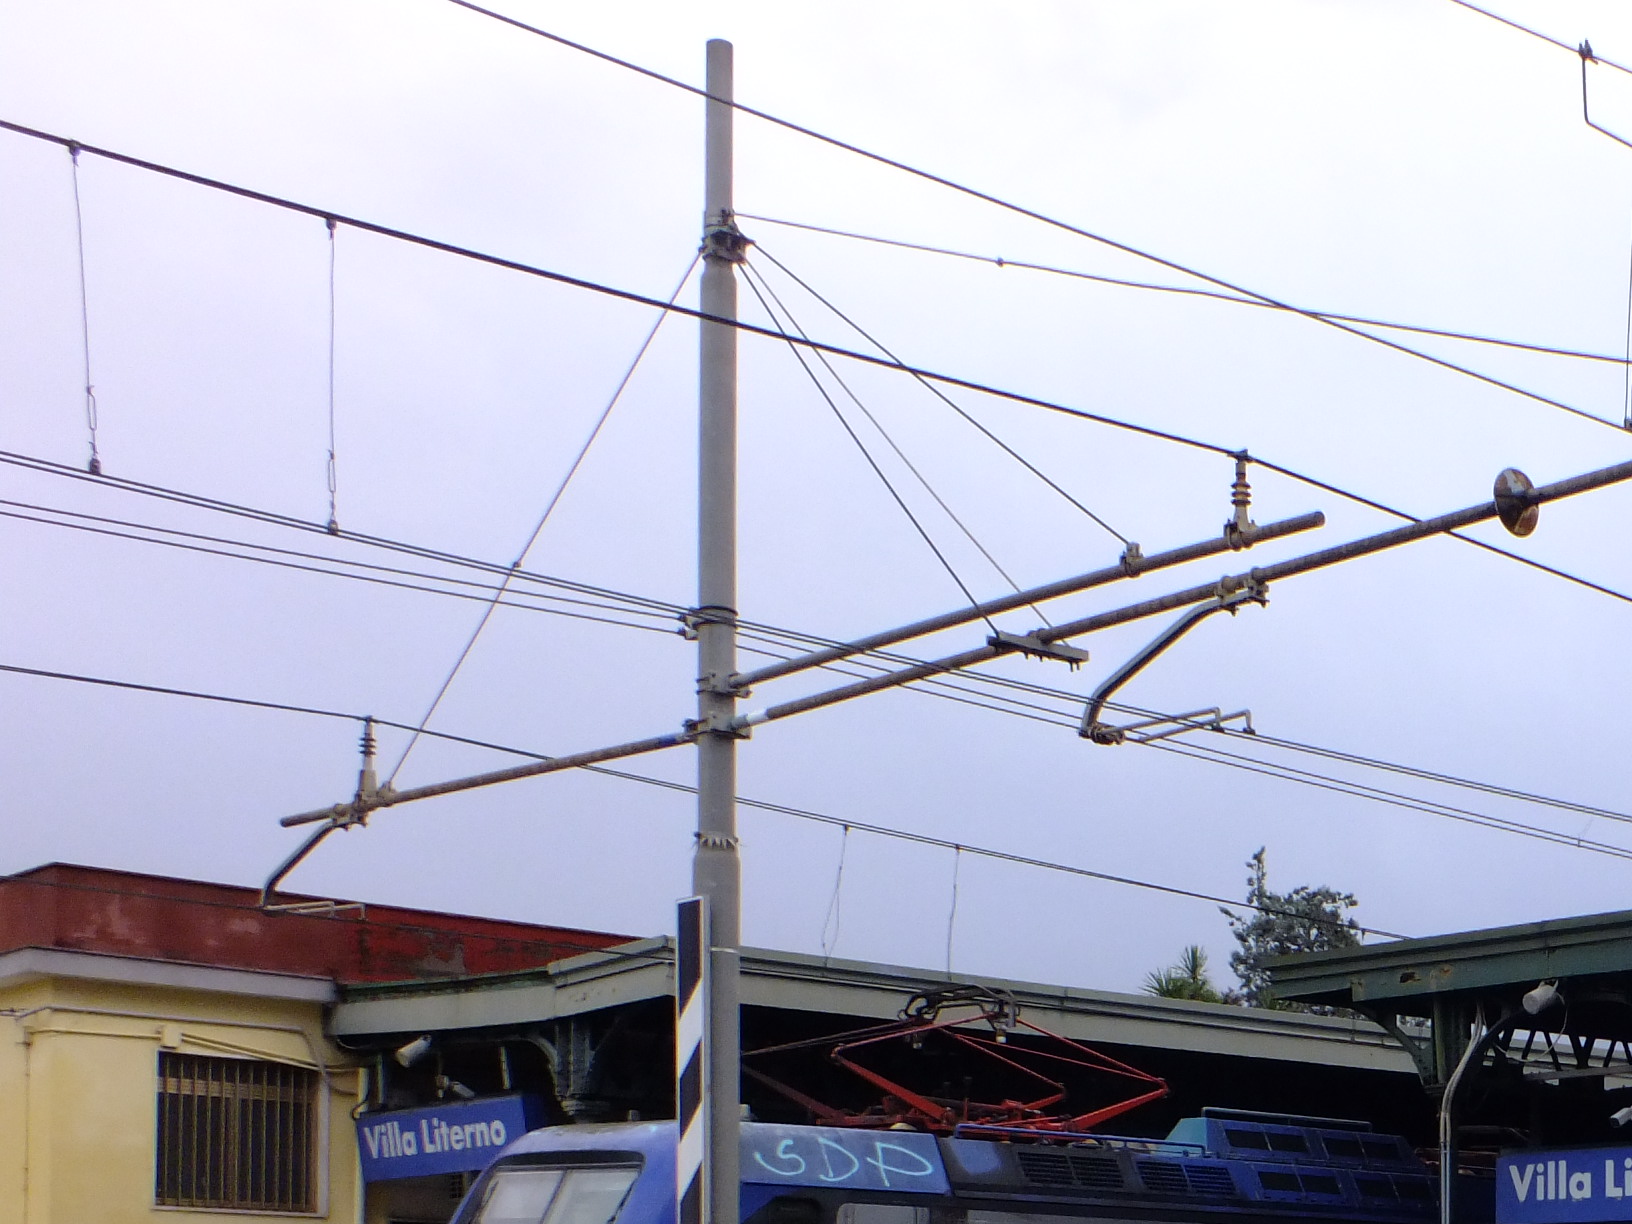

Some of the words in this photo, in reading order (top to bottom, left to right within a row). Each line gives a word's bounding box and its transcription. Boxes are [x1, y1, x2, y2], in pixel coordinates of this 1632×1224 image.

[364, 1120, 418, 1159] Villa
[420, 1117, 507, 1153] Literno
[1508, 1159, 1592, 1203] Villa
